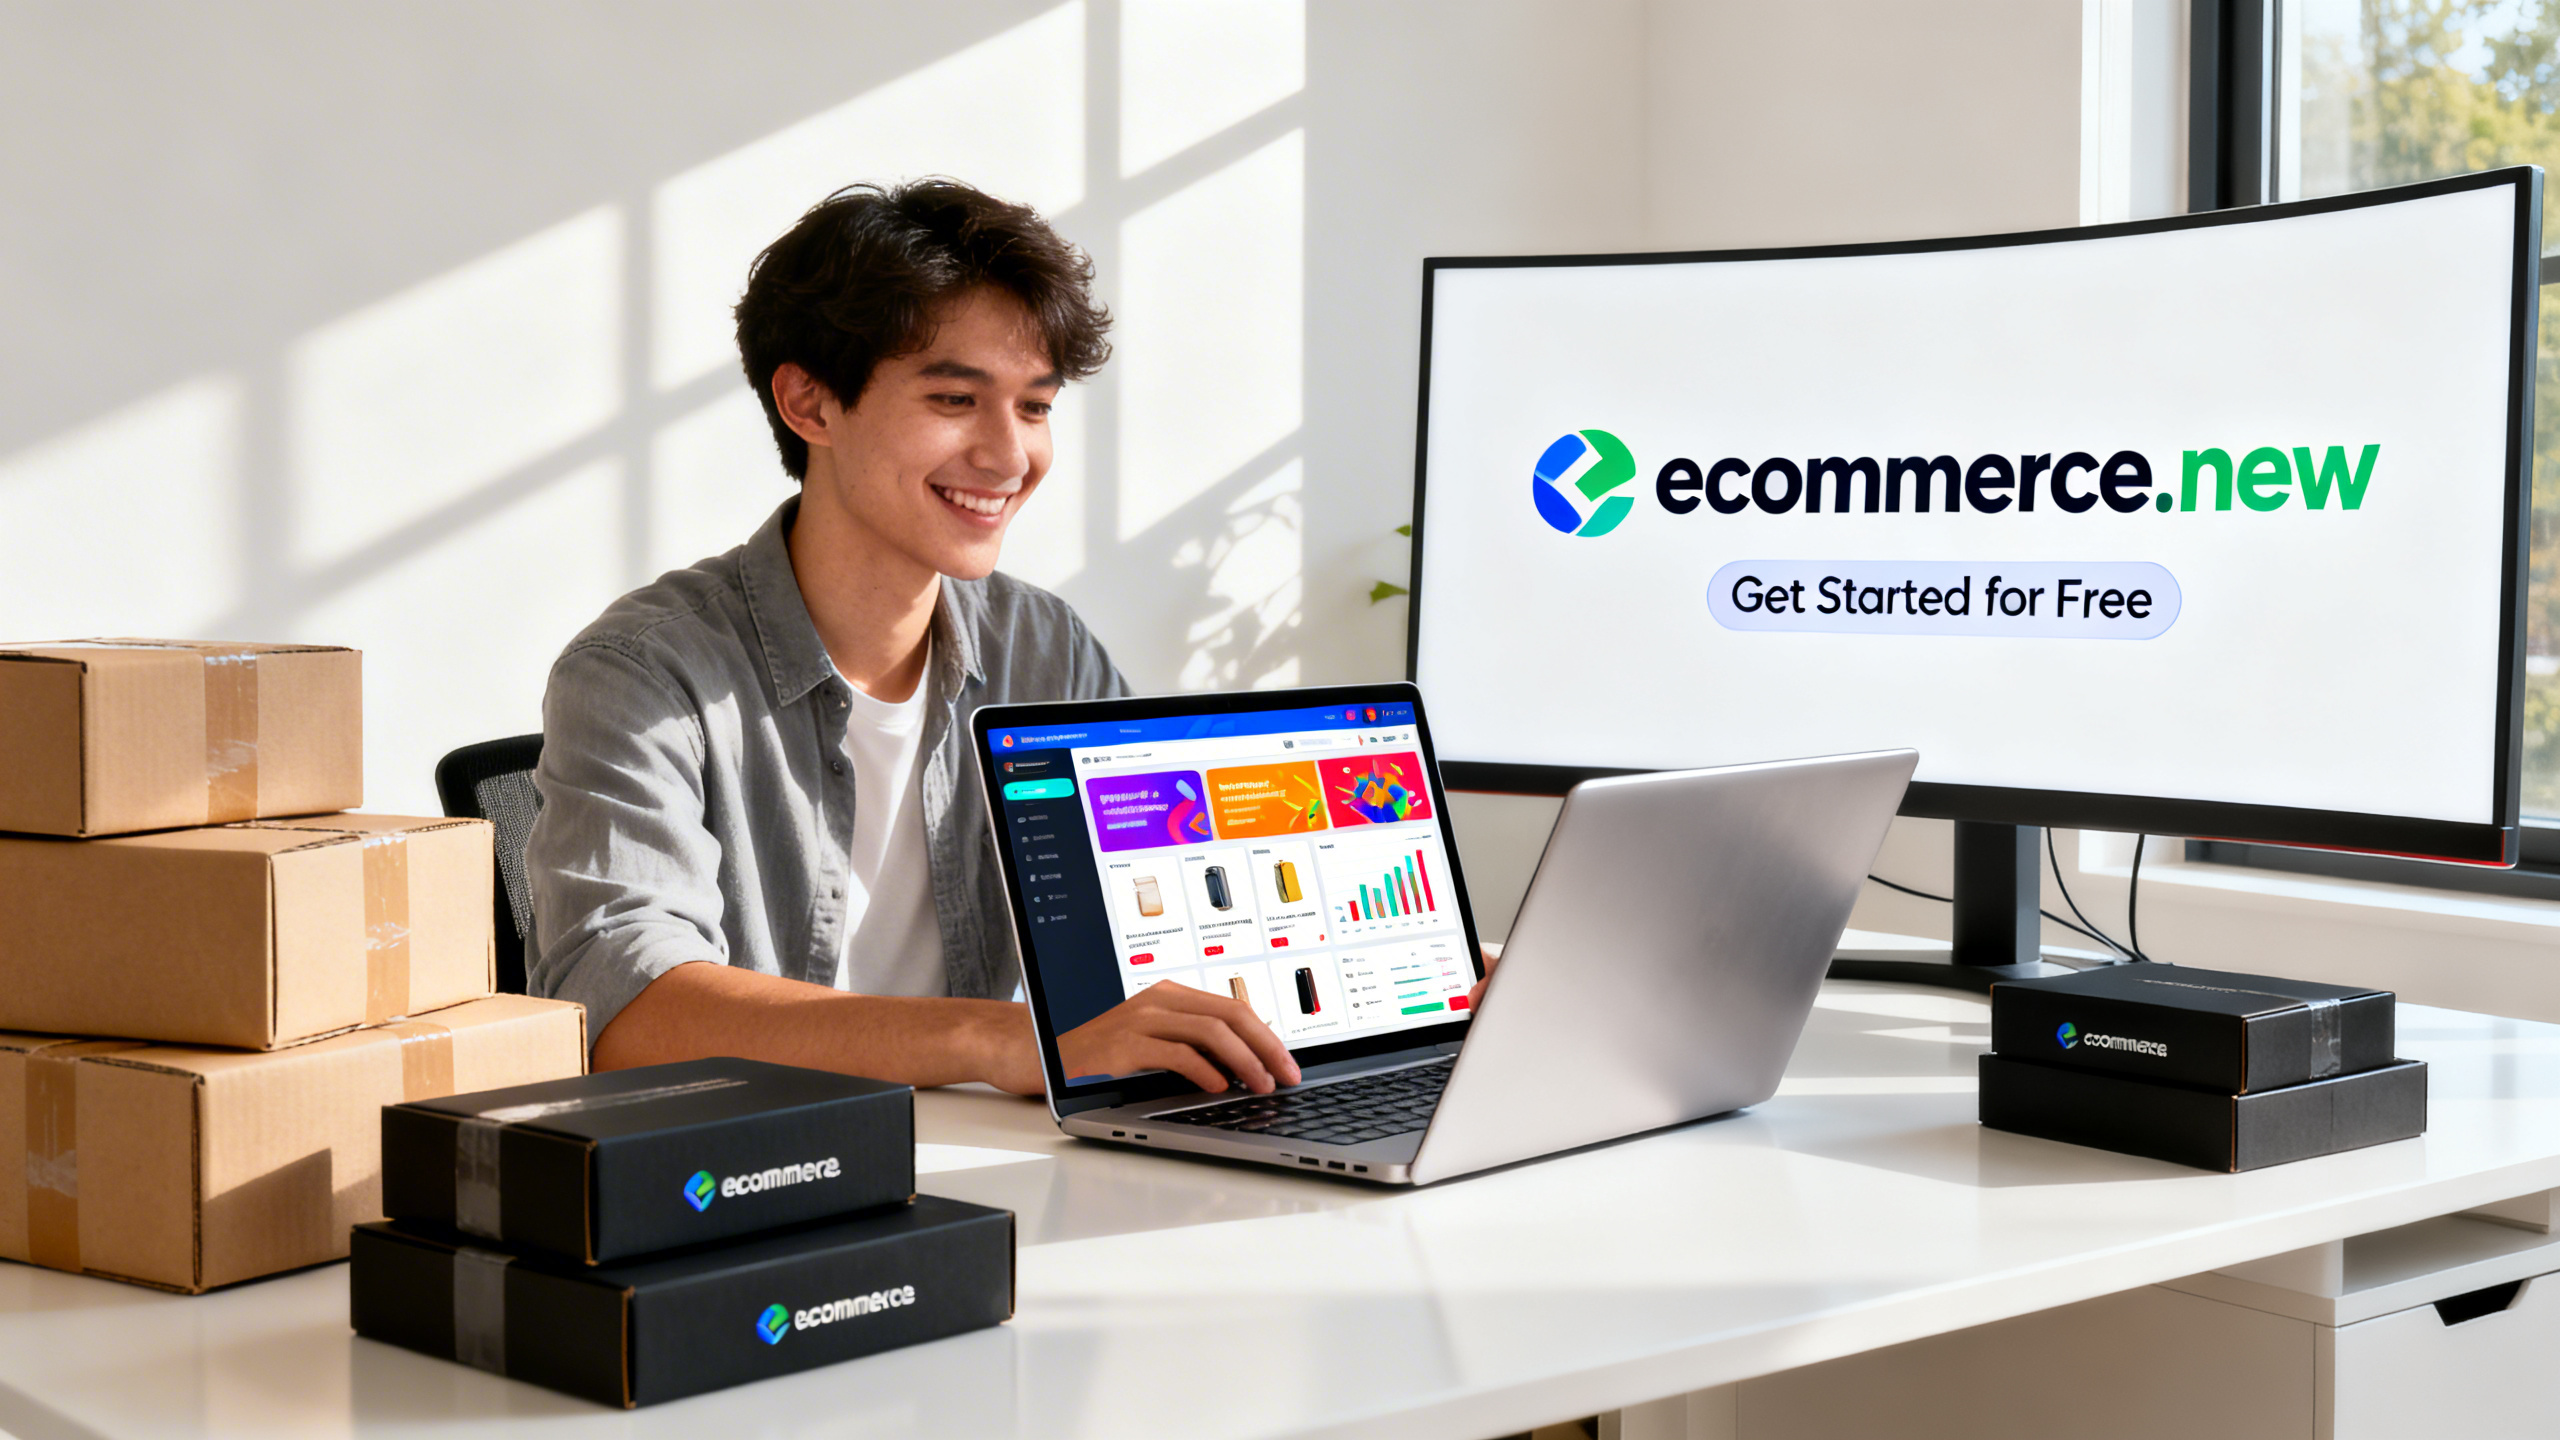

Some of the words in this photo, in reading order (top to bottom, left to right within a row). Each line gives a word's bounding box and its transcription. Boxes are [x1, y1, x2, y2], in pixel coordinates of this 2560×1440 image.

[1655, 443, 2381, 515] ecommerce.new
[1731, 575, 1806, 614] Get
[1816, 575, 1971, 617] Started
[1985, 575, 2045, 617] for
[2057, 578, 2153, 619] Free
